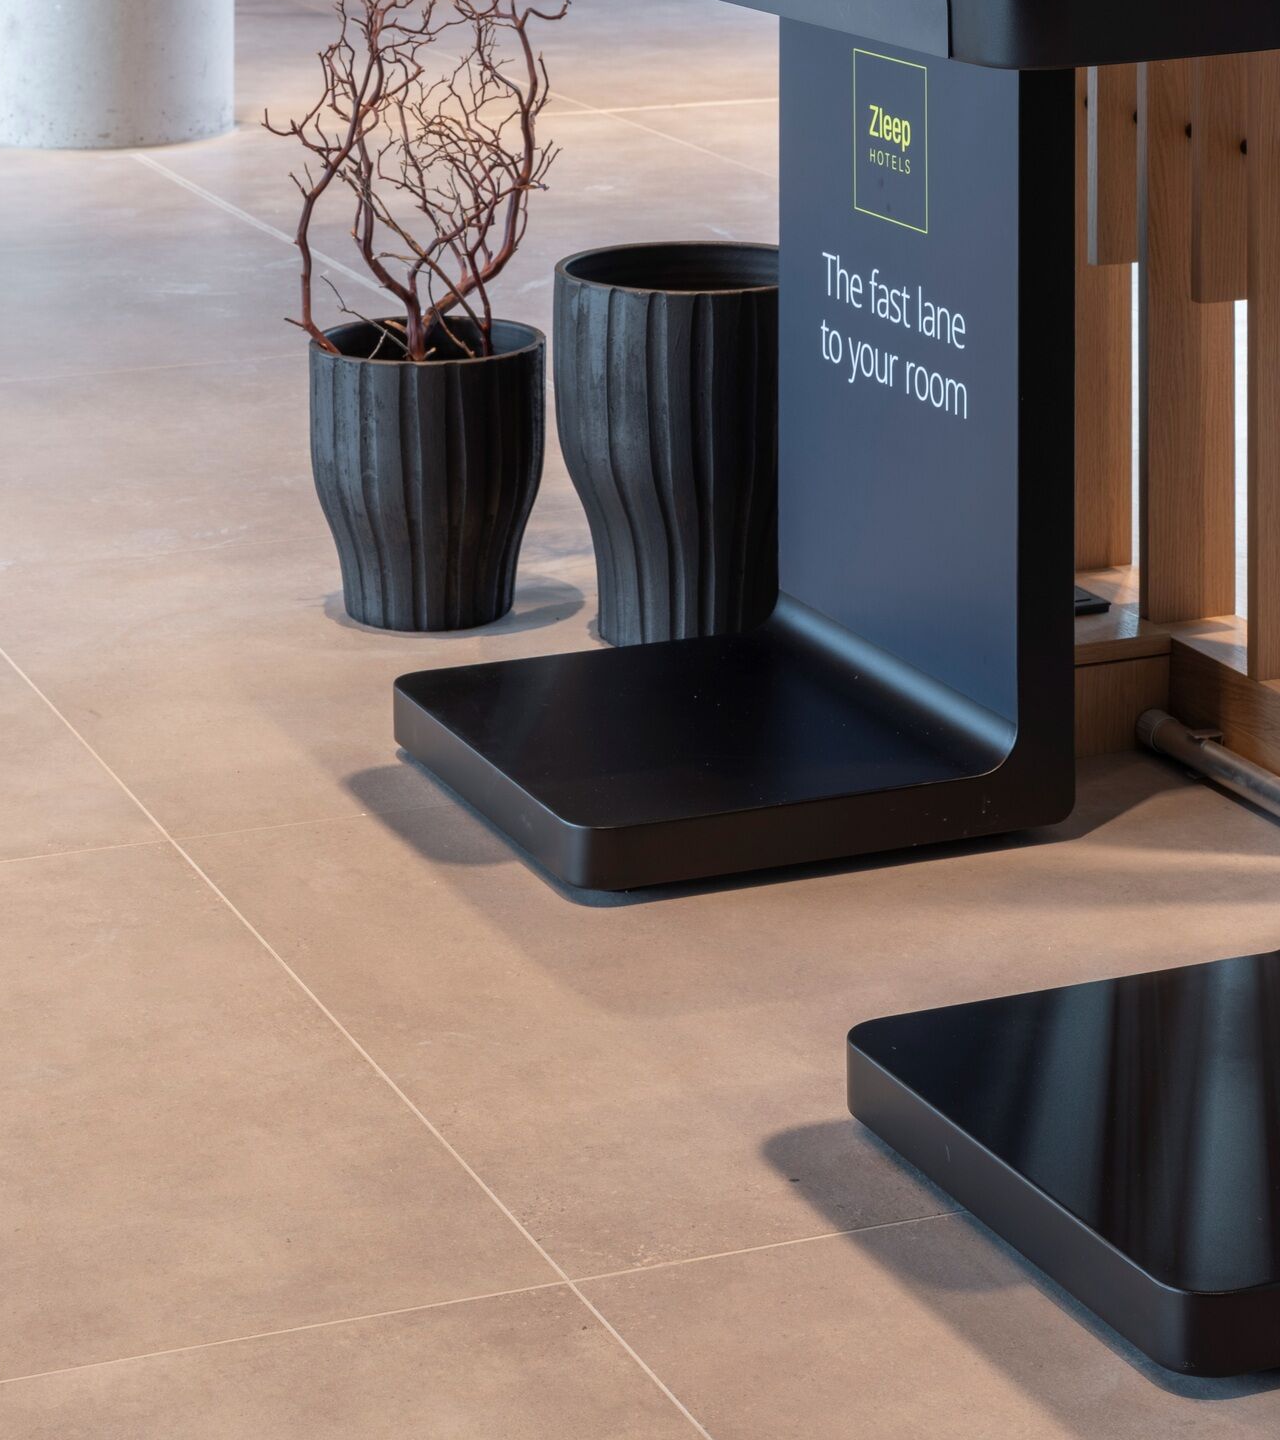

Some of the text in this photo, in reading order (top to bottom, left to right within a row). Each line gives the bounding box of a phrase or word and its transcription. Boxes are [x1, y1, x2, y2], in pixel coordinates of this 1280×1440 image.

[869, 104, 911, 153] Zleep
[869, 148, 911, 175] HOTELS
[821, 251, 966, 350] The fast lane
[820, 319, 968, 420] to your room
